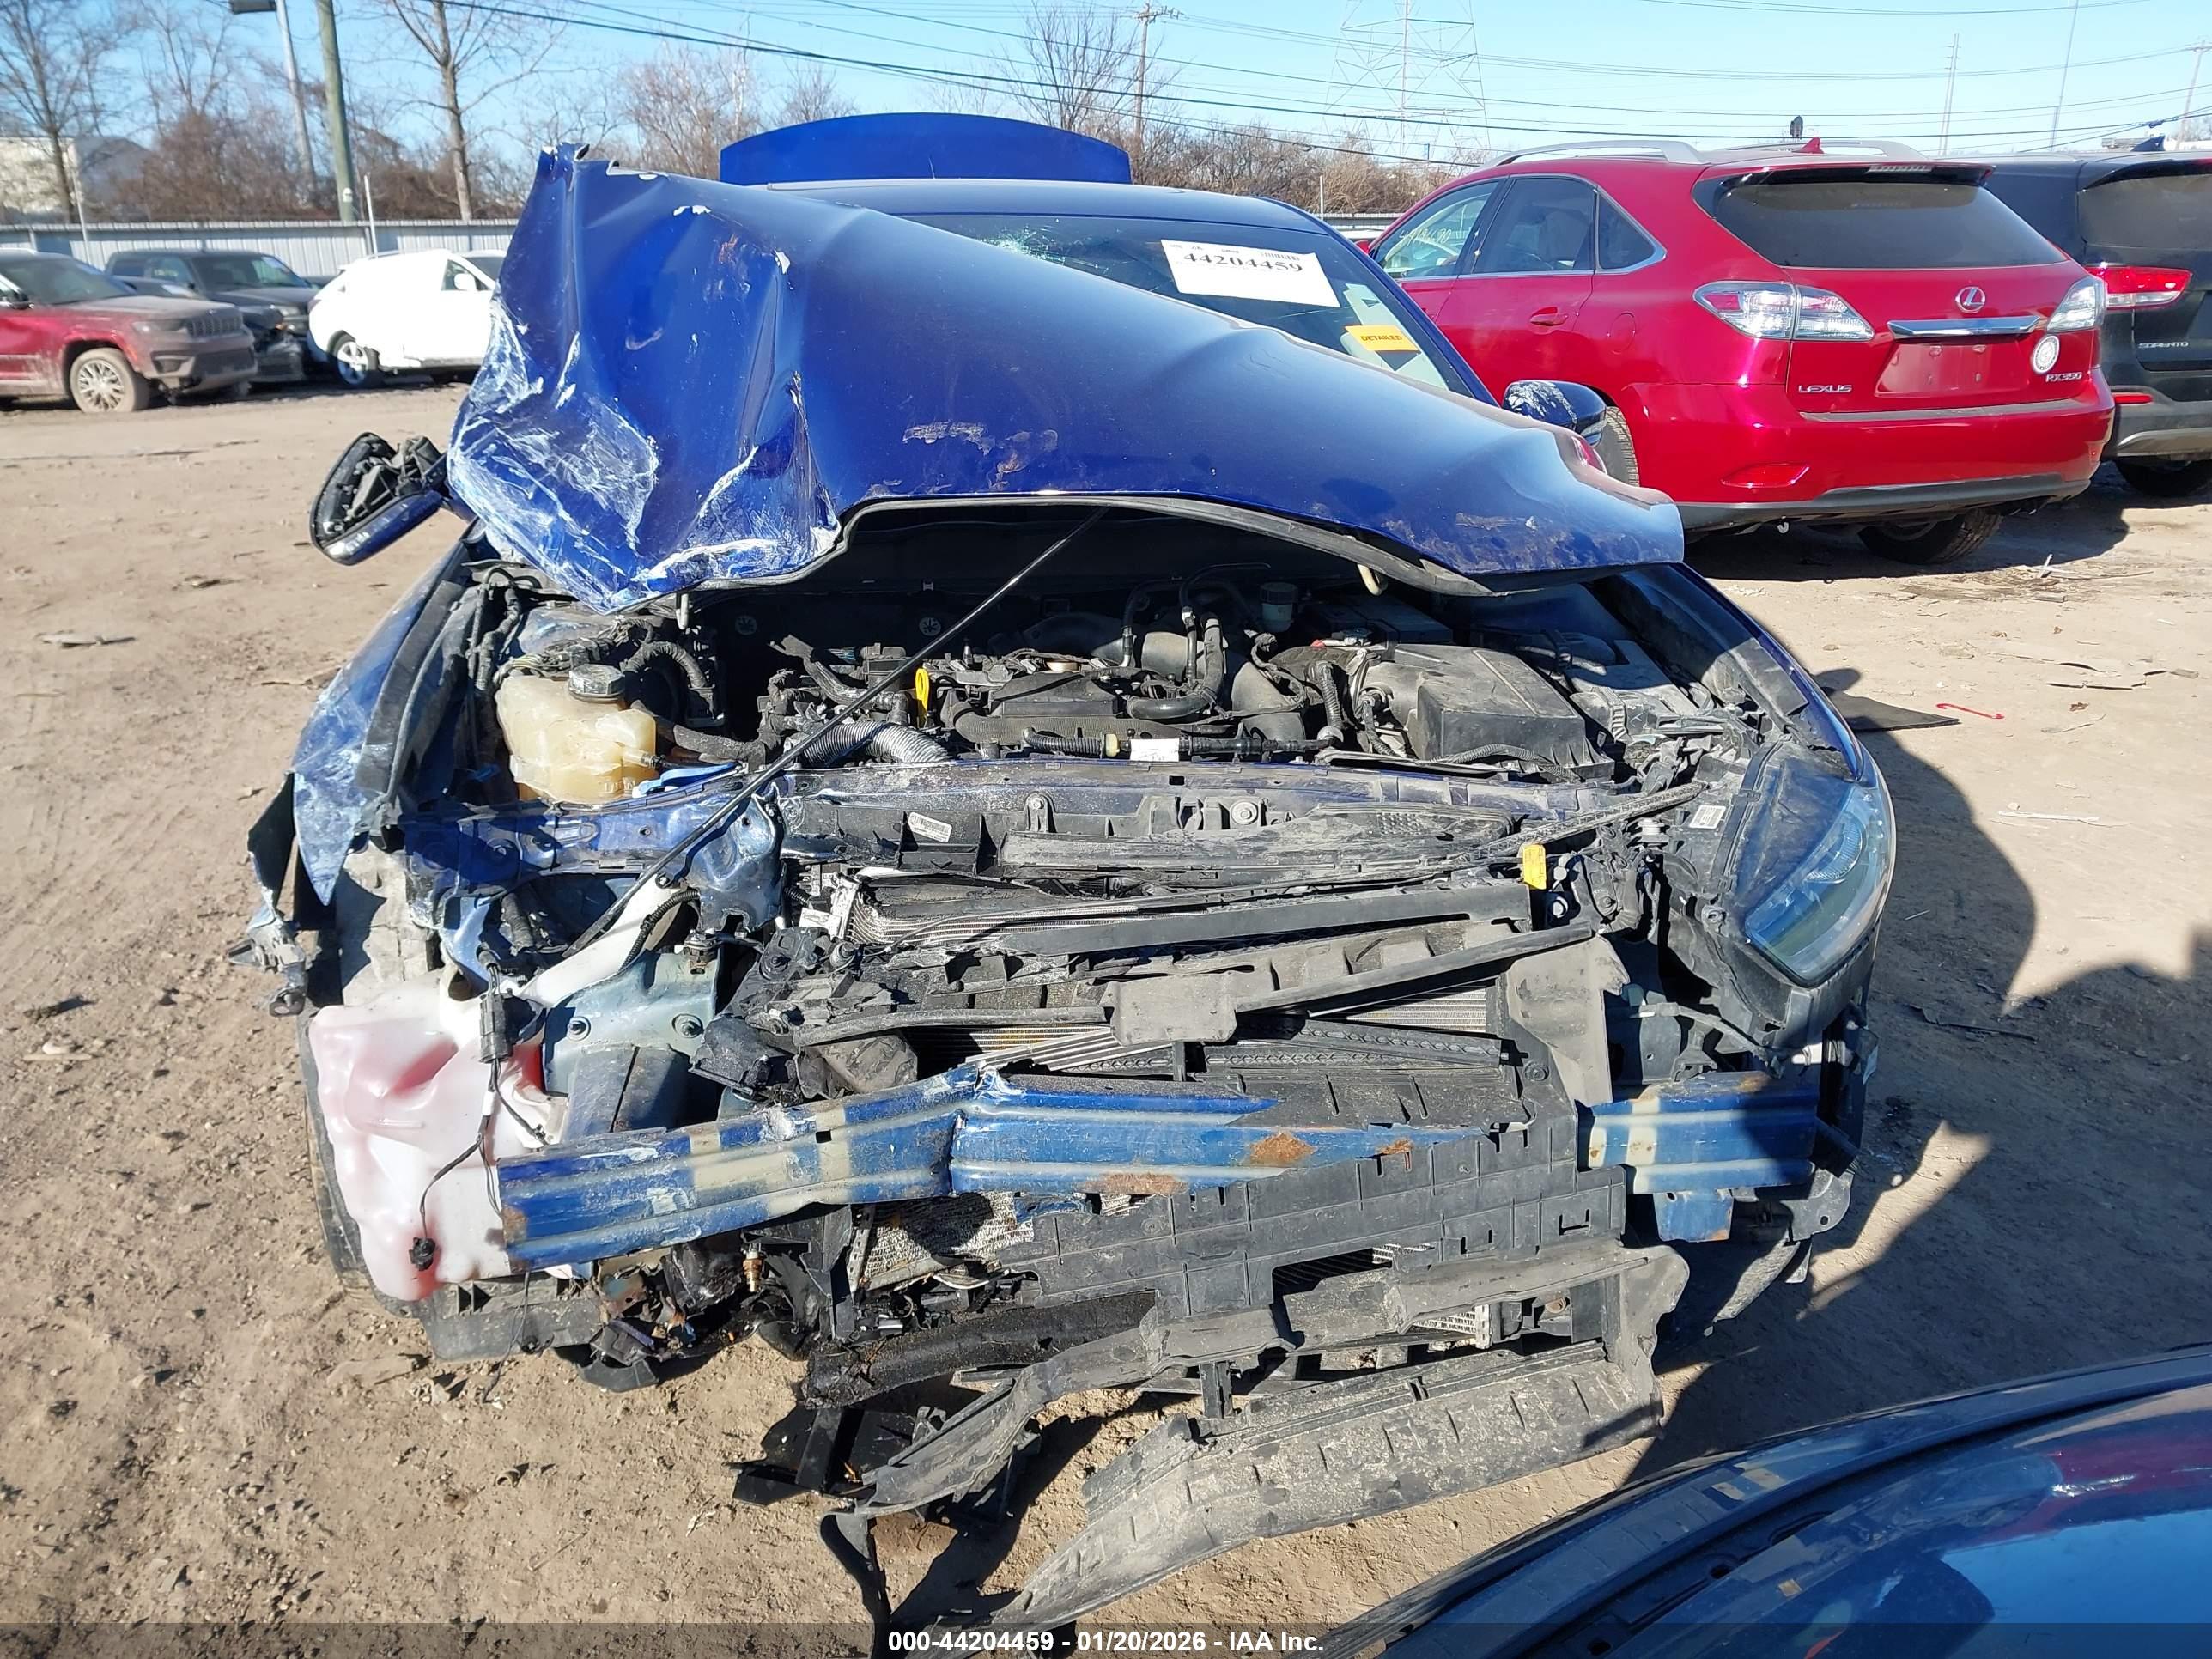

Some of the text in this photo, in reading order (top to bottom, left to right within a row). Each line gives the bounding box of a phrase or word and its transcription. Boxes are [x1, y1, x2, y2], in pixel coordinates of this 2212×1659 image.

[1183, 252, 1304, 272] 44204459
[2045, 371, 2083, 383] RX350
[1798, 384, 1853, 393] LEXUS
